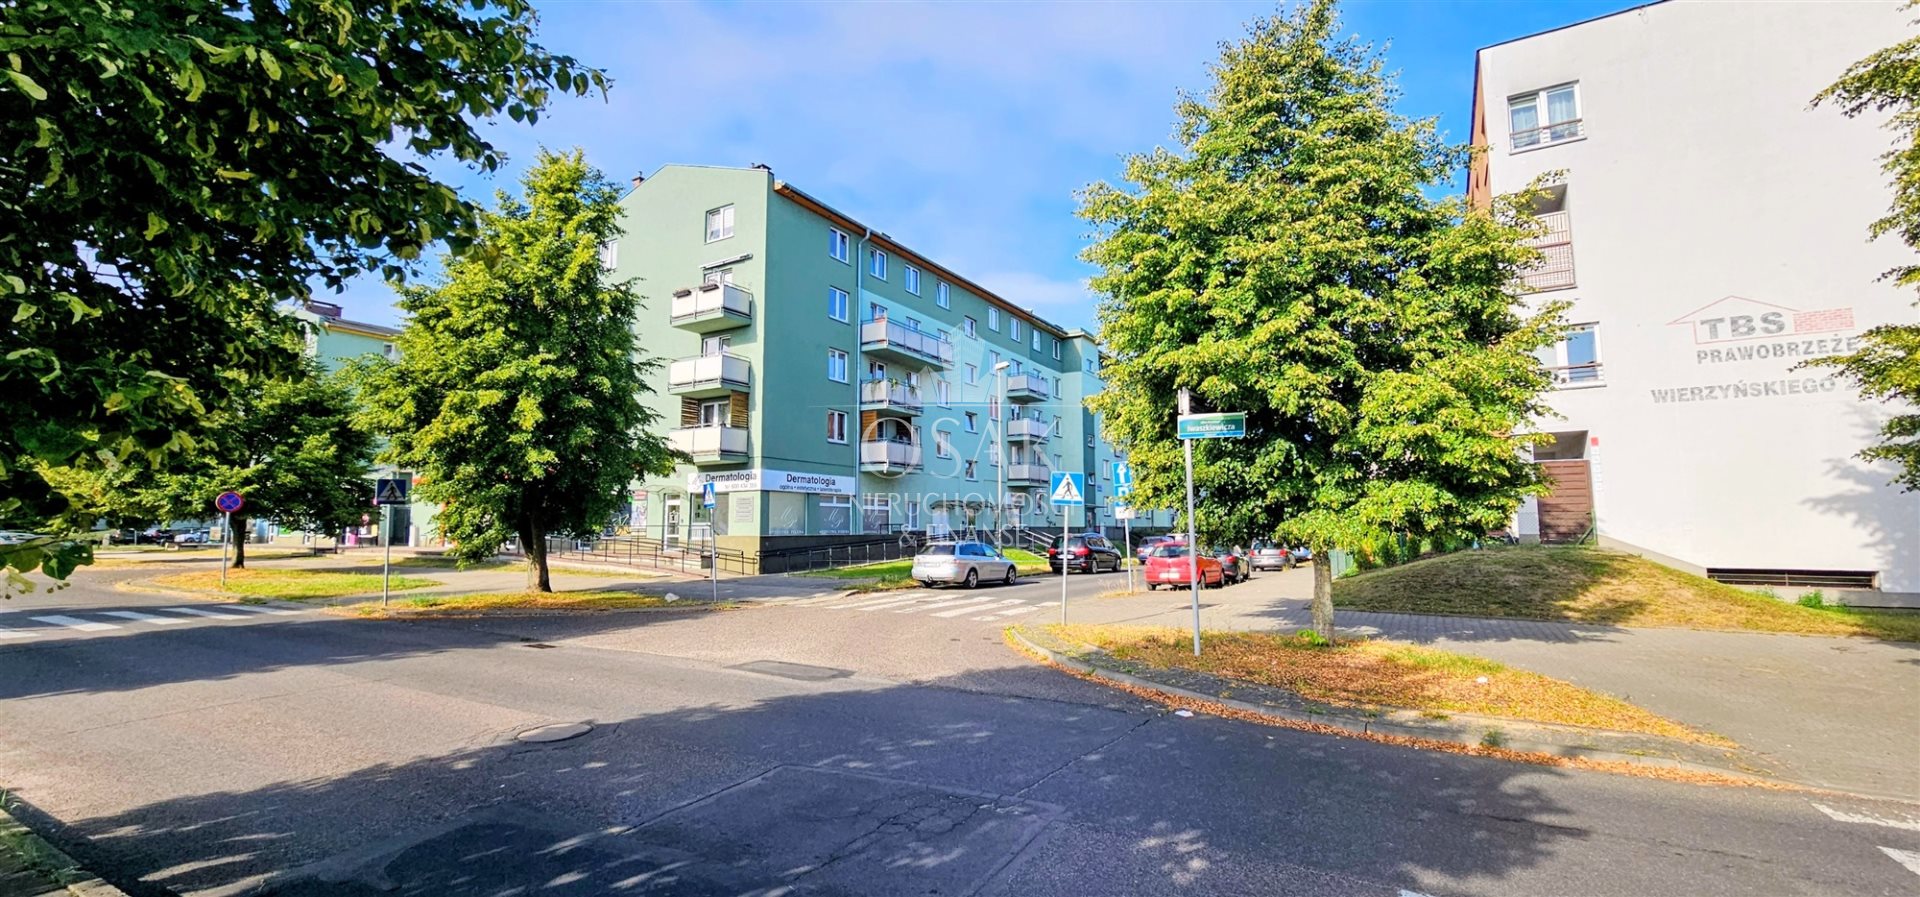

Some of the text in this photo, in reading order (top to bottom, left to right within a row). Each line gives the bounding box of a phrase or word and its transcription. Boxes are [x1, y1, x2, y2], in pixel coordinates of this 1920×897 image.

[1700, 311, 1785, 339] TBS
[1697, 334, 1859, 364] PRAWOBRZEŻE
[1651, 379, 1836, 403] WIERZYŃSKIEGO
[705, 471, 757, 483] Dermatologia
[786, 473, 836, 486] Dermatologia
